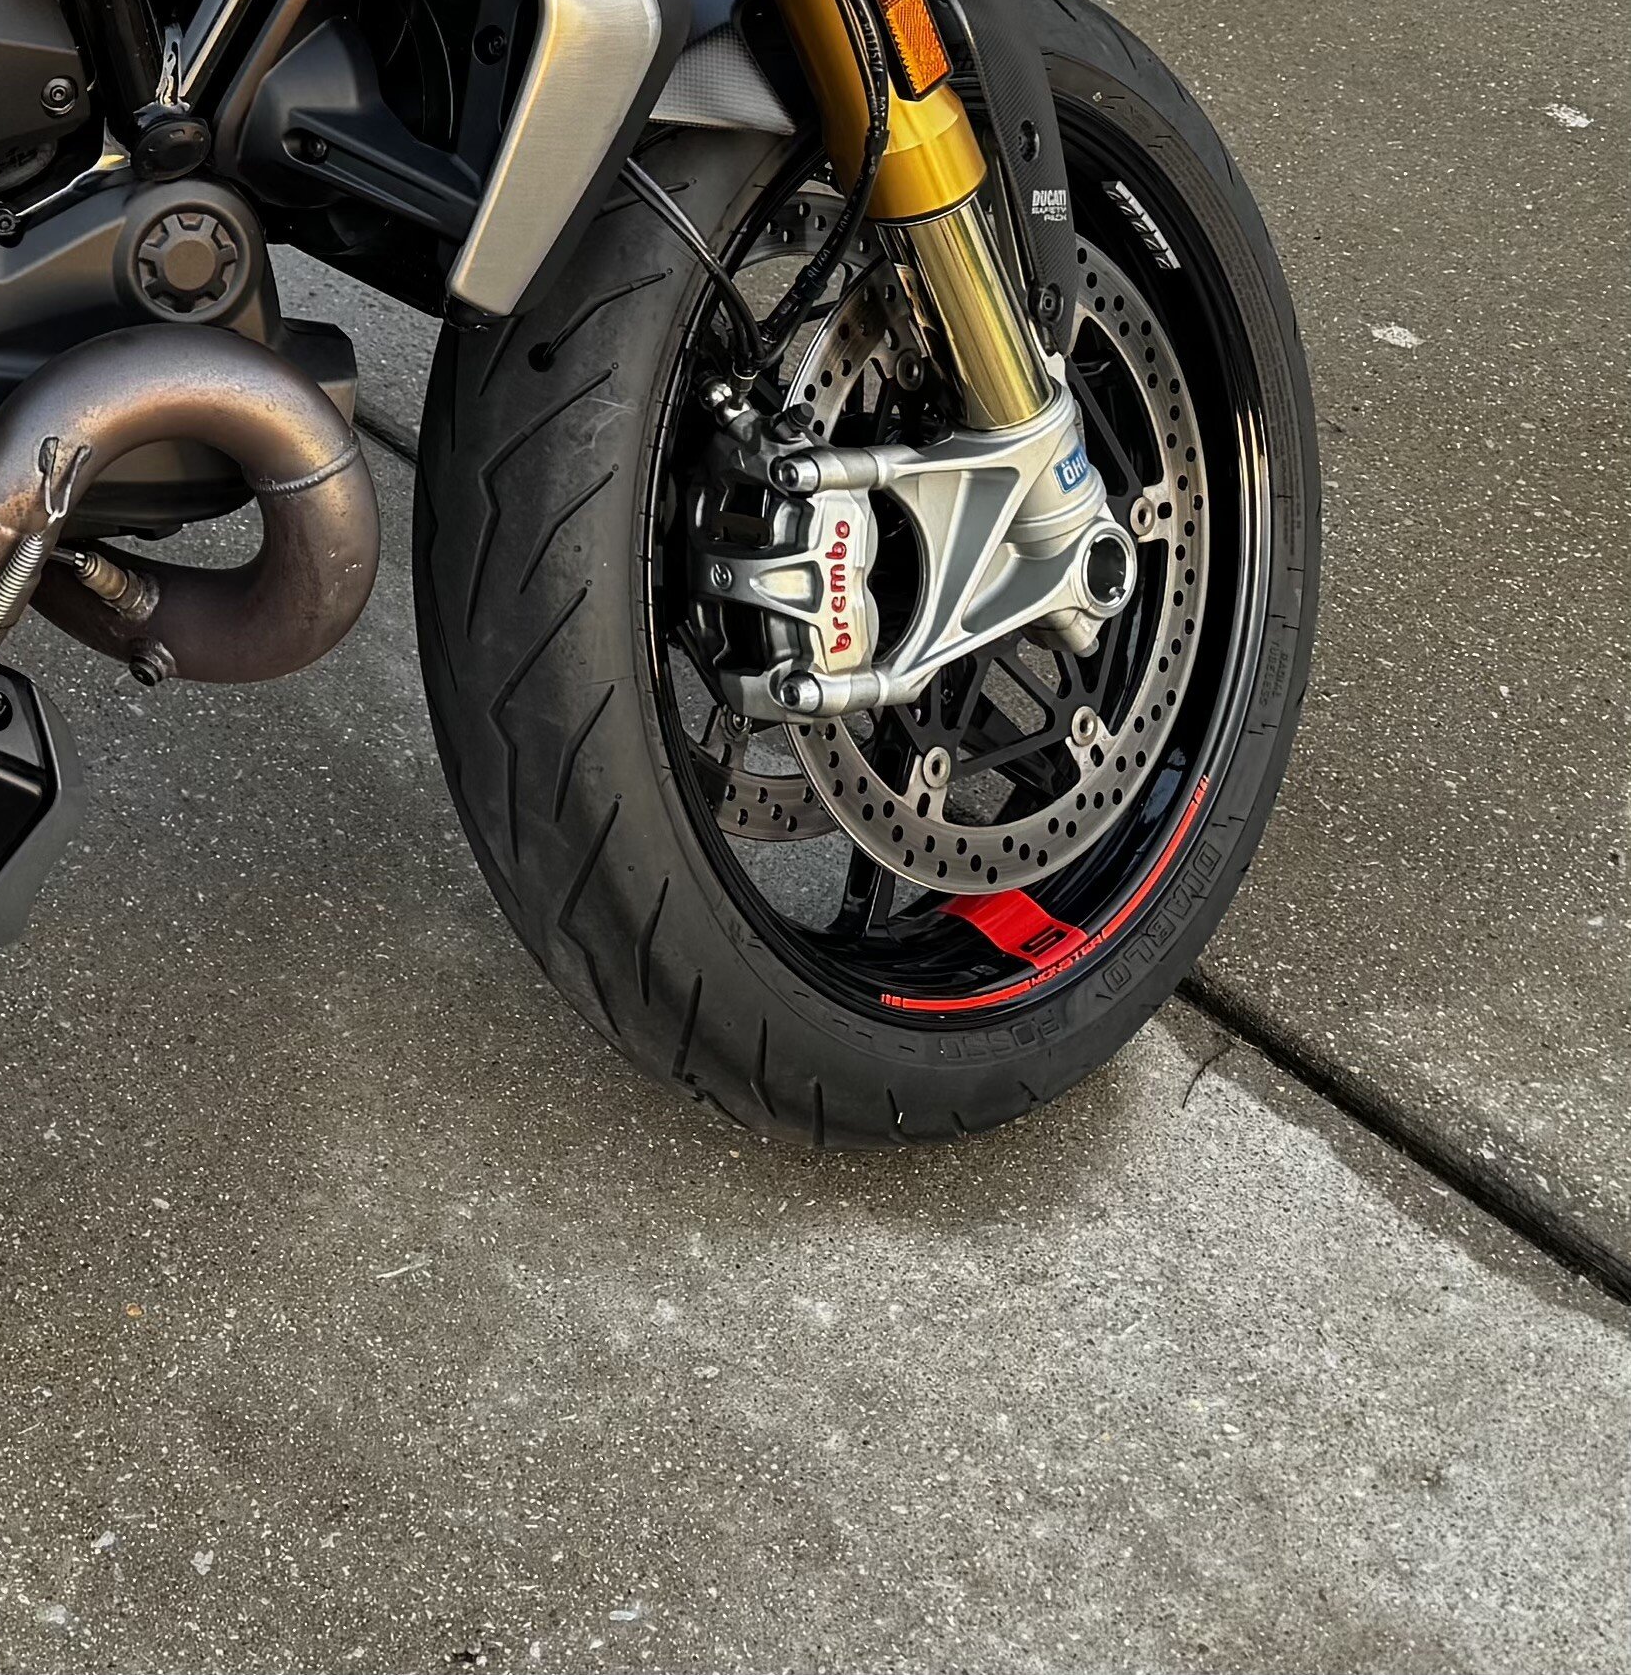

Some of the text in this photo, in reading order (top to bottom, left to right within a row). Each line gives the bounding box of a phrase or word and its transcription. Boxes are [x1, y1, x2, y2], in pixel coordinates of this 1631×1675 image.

[1031, 206, 1067, 215] SAFETY
[1032, 189, 1067, 207] DUCATI
[1060, 453, 1088, 487] ÖHL
[824, 520, 851, 654] brembo
[1101, 839, 1223, 994] DIABLO
[1030, 932, 1104, 987] MONSTER
